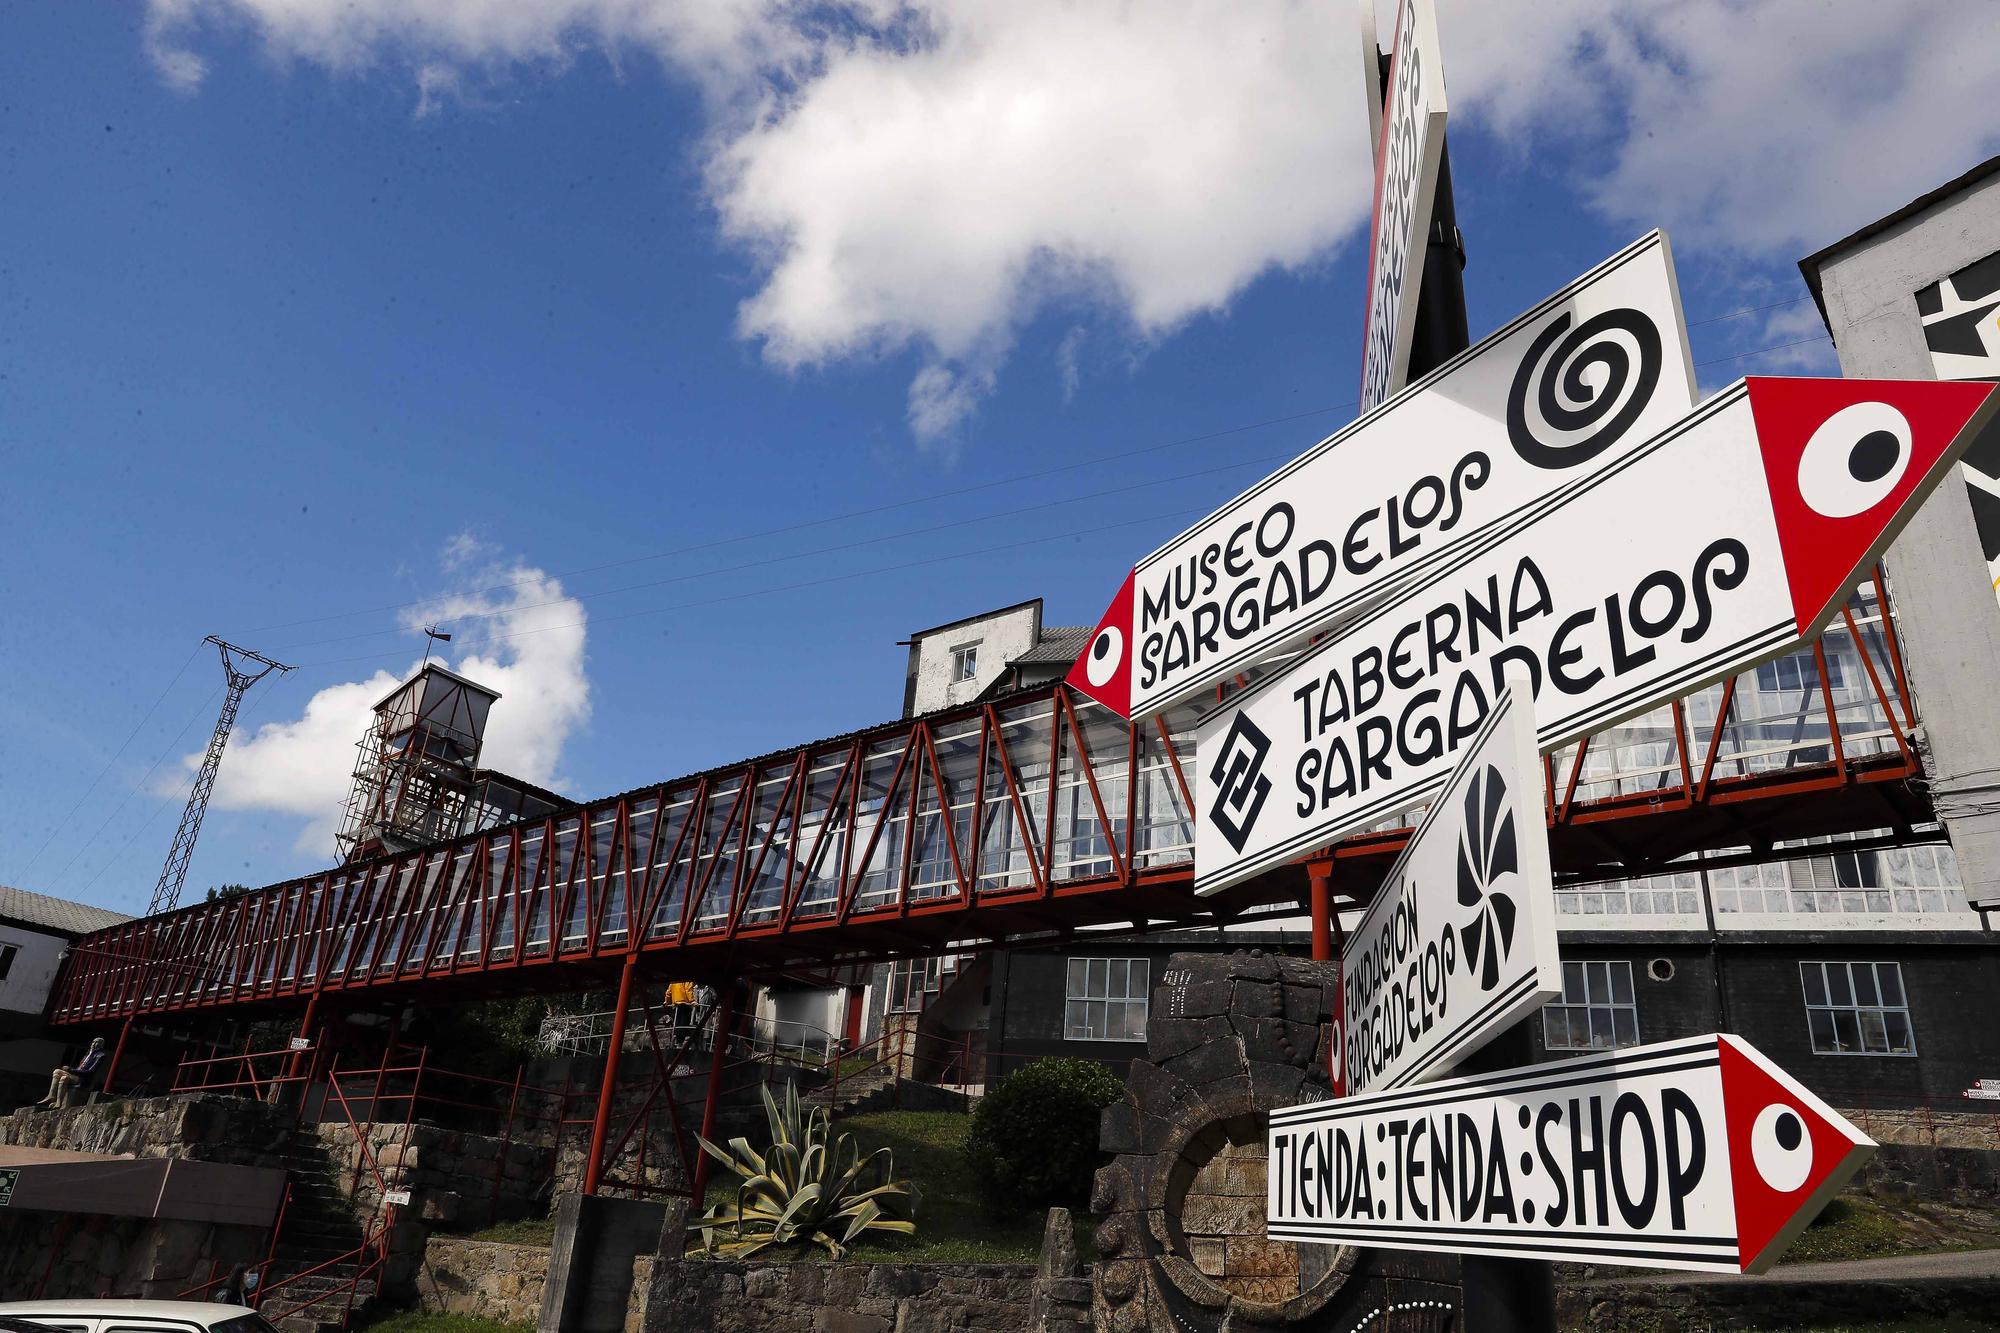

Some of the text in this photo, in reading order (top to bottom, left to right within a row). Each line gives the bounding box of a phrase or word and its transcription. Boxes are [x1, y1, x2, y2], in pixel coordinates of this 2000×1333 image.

[1141, 451, 1491, 690] SARGADELOS
[1142, 501, 1296, 634] MUSEO
[1293, 555, 1554, 744] TABERNA
[1345, 875, 1420, 1031] FUNDACIÓN
[1346, 922, 1456, 1097] SARGADELOS
[1535, 1087, 1707, 1231] SHOP
